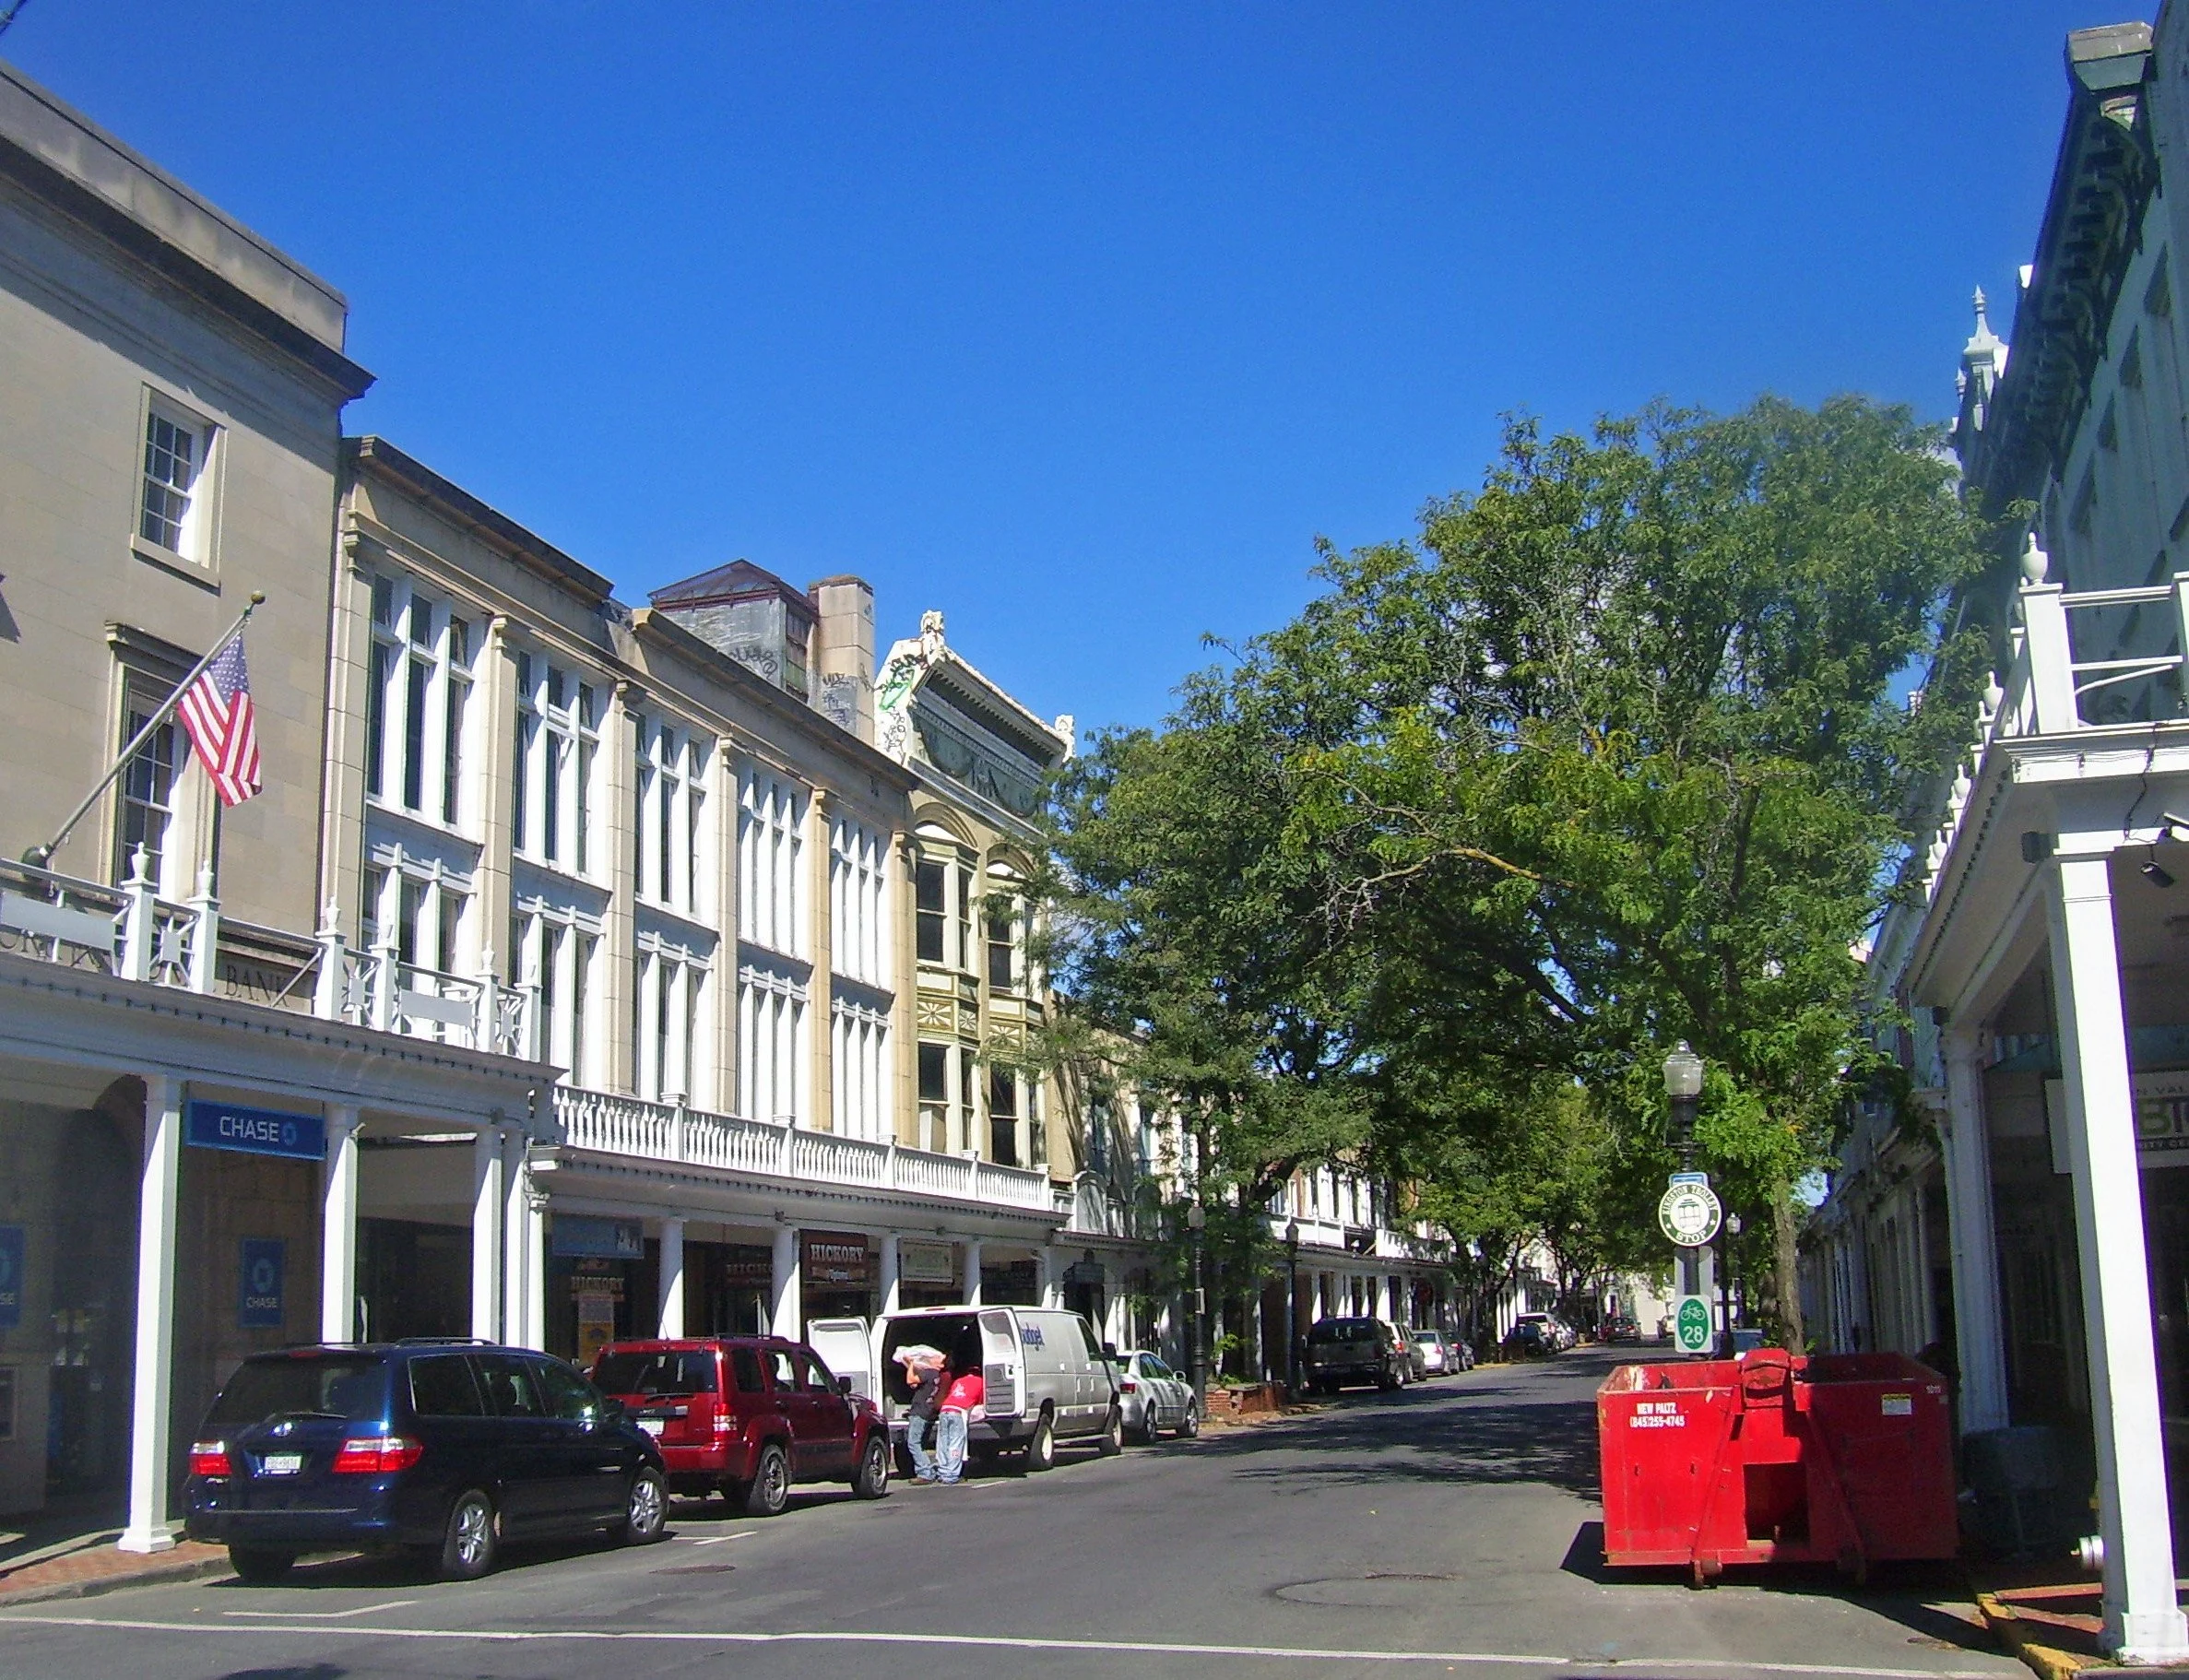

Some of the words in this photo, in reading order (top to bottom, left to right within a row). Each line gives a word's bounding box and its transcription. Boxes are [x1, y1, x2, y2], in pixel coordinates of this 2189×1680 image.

[224, 964, 290, 1007] BANK
[219, 1116, 279, 1142] CHASE
[1676, 1230, 1707, 1242] STOP
[811, 1244, 865, 1262] HICKORY
[246, 1296, 278, 1308] CHASE
[1021, 1322, 1045, 1351] udget
[1684, 1325, 1703, 1343] 28
[1637, 1402, 1653, 1414] NEW
[1655, 1402, 1676, 1414] PALTZ
